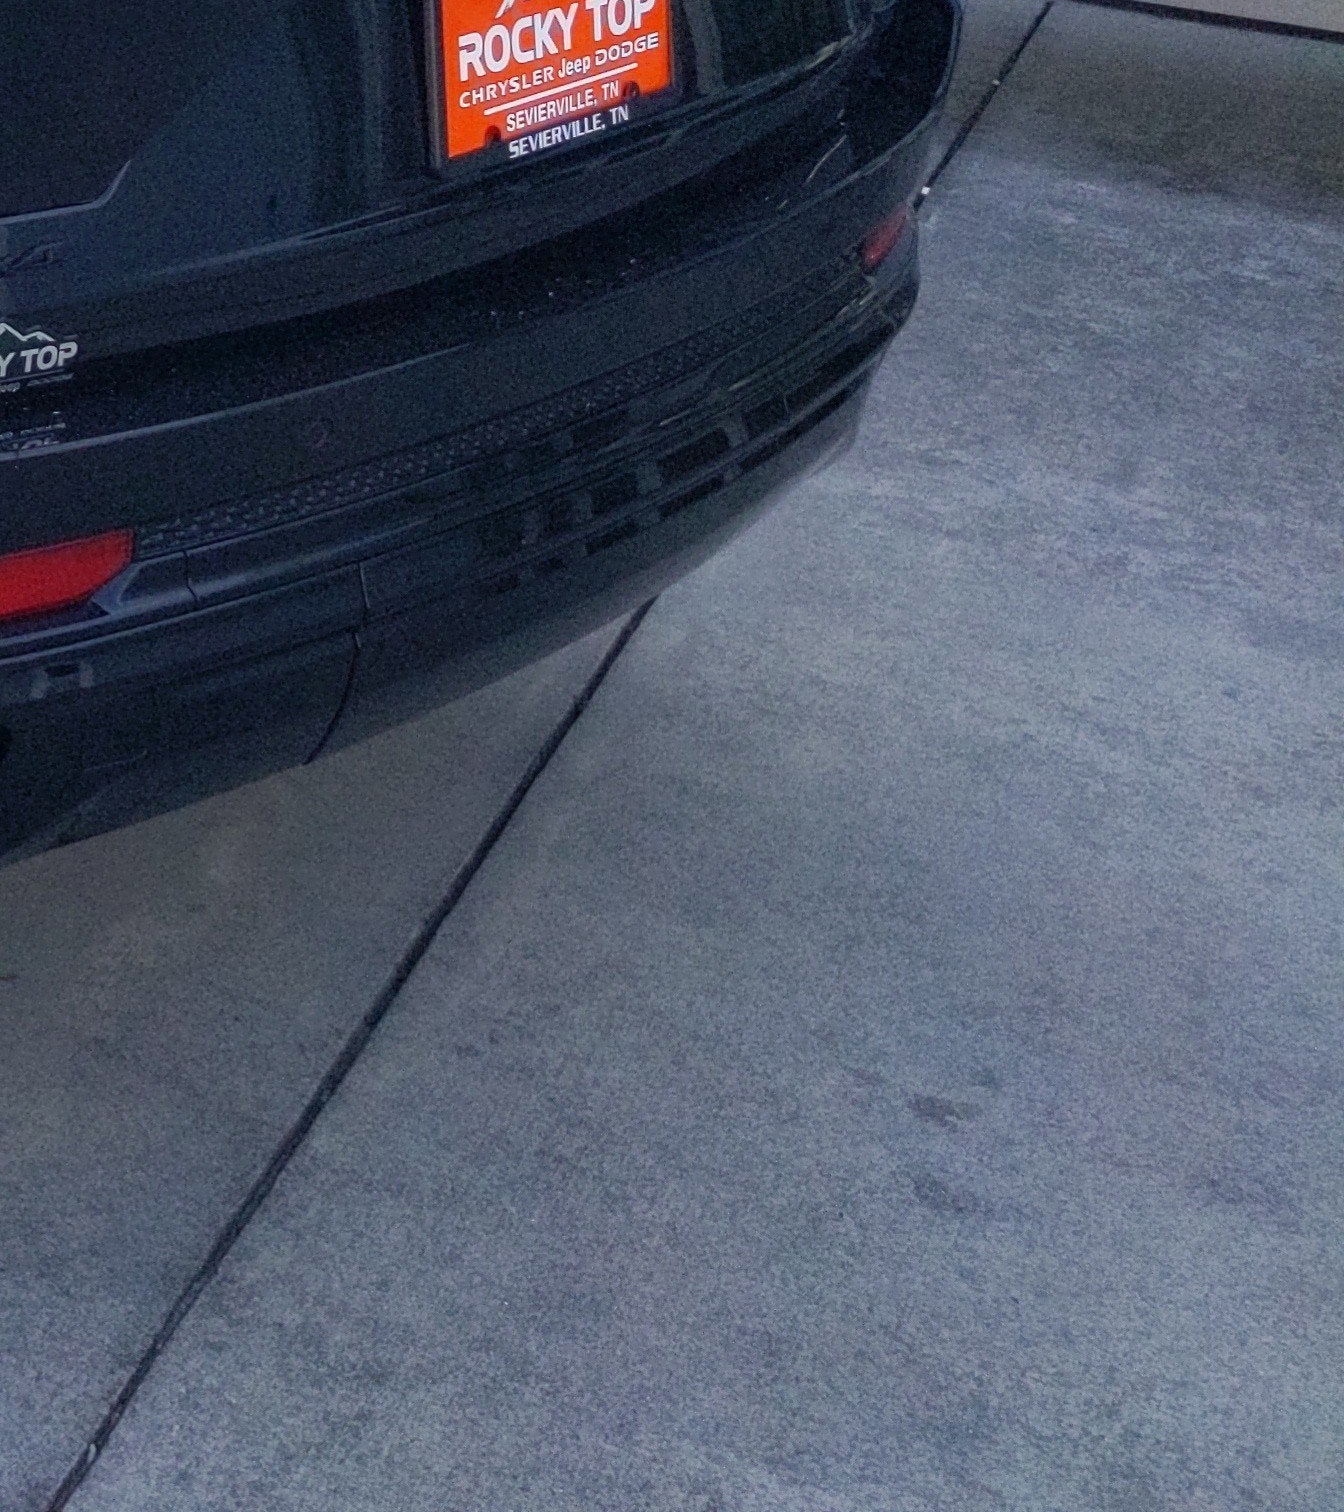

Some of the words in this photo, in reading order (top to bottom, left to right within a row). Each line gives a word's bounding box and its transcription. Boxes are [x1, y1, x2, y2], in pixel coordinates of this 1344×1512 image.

[458, 3, 579, 82] ROCKY
[459, 66, 554, 109] CHRYSLER
[558, 55, 591, 79] Jeep
[595, 32, 660, 66] DODGE
[506, 89, 598, 133] SEVIERVILLE,
[601, 80, 620, 102] TN
[509, 113, 606, 159] SEVIERVILLE,
[609, 105, 629, 125] TN
[20, 341, 79, 373] TOP
